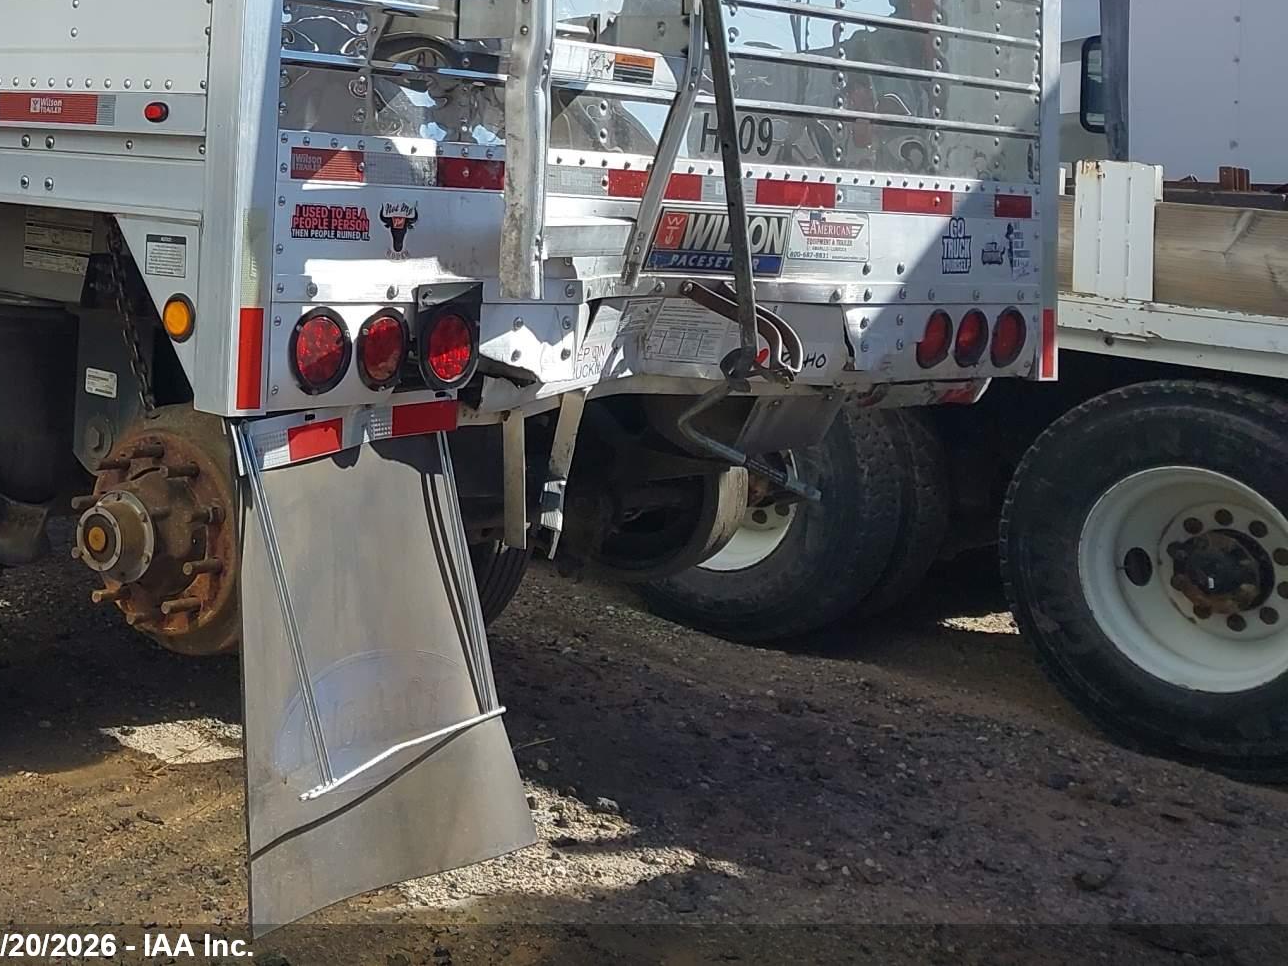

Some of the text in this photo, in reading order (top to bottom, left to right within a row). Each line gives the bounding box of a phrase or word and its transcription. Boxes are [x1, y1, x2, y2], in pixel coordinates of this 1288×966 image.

[40, 106, 62, 114] TRAILER
[41, 98, 62, 107] Wilson
[700, 112, 773, 156] H09
[296, 153, 322, 164] Wilson
[302, 206, 329, 218] USED
[330, 207, 343, 219] TO
[345, 208, 358, 220] BE
[359, 208, 367, 220] A
[292, 217, 369, 232] PEOPLE PERSON
[810, 220, 851, 236] AMERICAN
[949, 217, 965, 238] GO
[292, 228, 309, 238] THEN
[310, 229, 336, 239] PEOPLE
[336, 230, 361, 240] RUINED
[682, 213, 788, 254] WILON
[943, 237, 970, 259] TRUCK
[670, 253, 760, 271] PACESETR
[942, 258, 971, 272] YOURSELF
